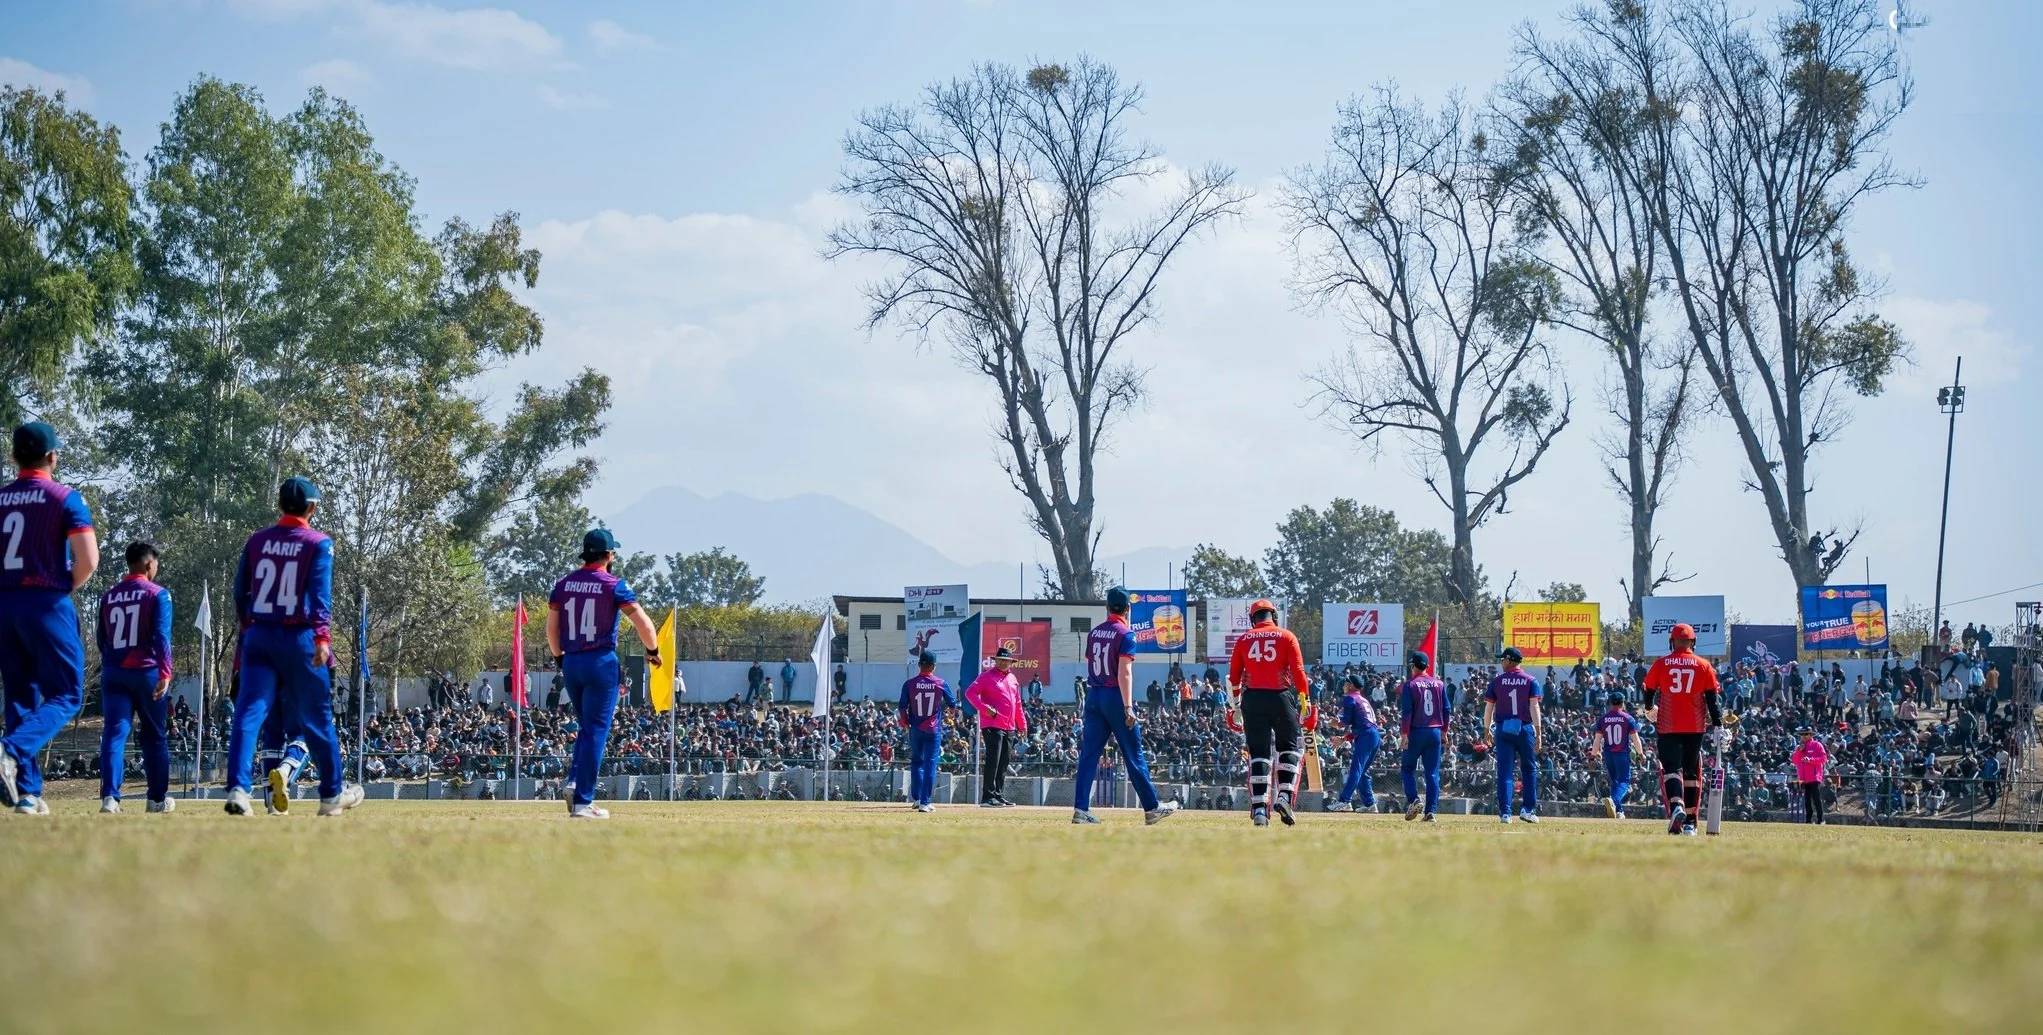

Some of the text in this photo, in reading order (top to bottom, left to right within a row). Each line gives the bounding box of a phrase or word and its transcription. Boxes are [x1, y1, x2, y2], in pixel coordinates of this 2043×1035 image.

[3, 512, 25, 570] 2
[262, 540, 303, 557] AARIF
[253, 558, 298, 616] 24
[564, 581, 602, 594] BHURTEL
[107, 590, 146, 604] LALIT
[110, 604, 140, 650] 27
[564, 597, 596, 641] 14
[1131, 620, 1150, 631] RUE
[1711, 623, 1718, 633] 1
[1806, 617, 1849, 629] YOUR TRUE
[1091, 629, 1117, 639] PAWAN
[1243, 631, 1282, 641] JOHNSON
[1092, 642, 1110, 677] 31
[1247, 640, 1277, 662] 45
[1328, 643, 1398, 657] FIBERNET
[1664, 658, 1699, 667] DHALIWAL
[1502, 678, 1527, 686] RIJAN
[1669, 668, 1695, 693] 37
[914, 692, 935, 717] 17
[1423, 689, 1434, 716] 8
[1508, 688, 1518, 715] 1
[1605, 724, 1622, 745] 10
